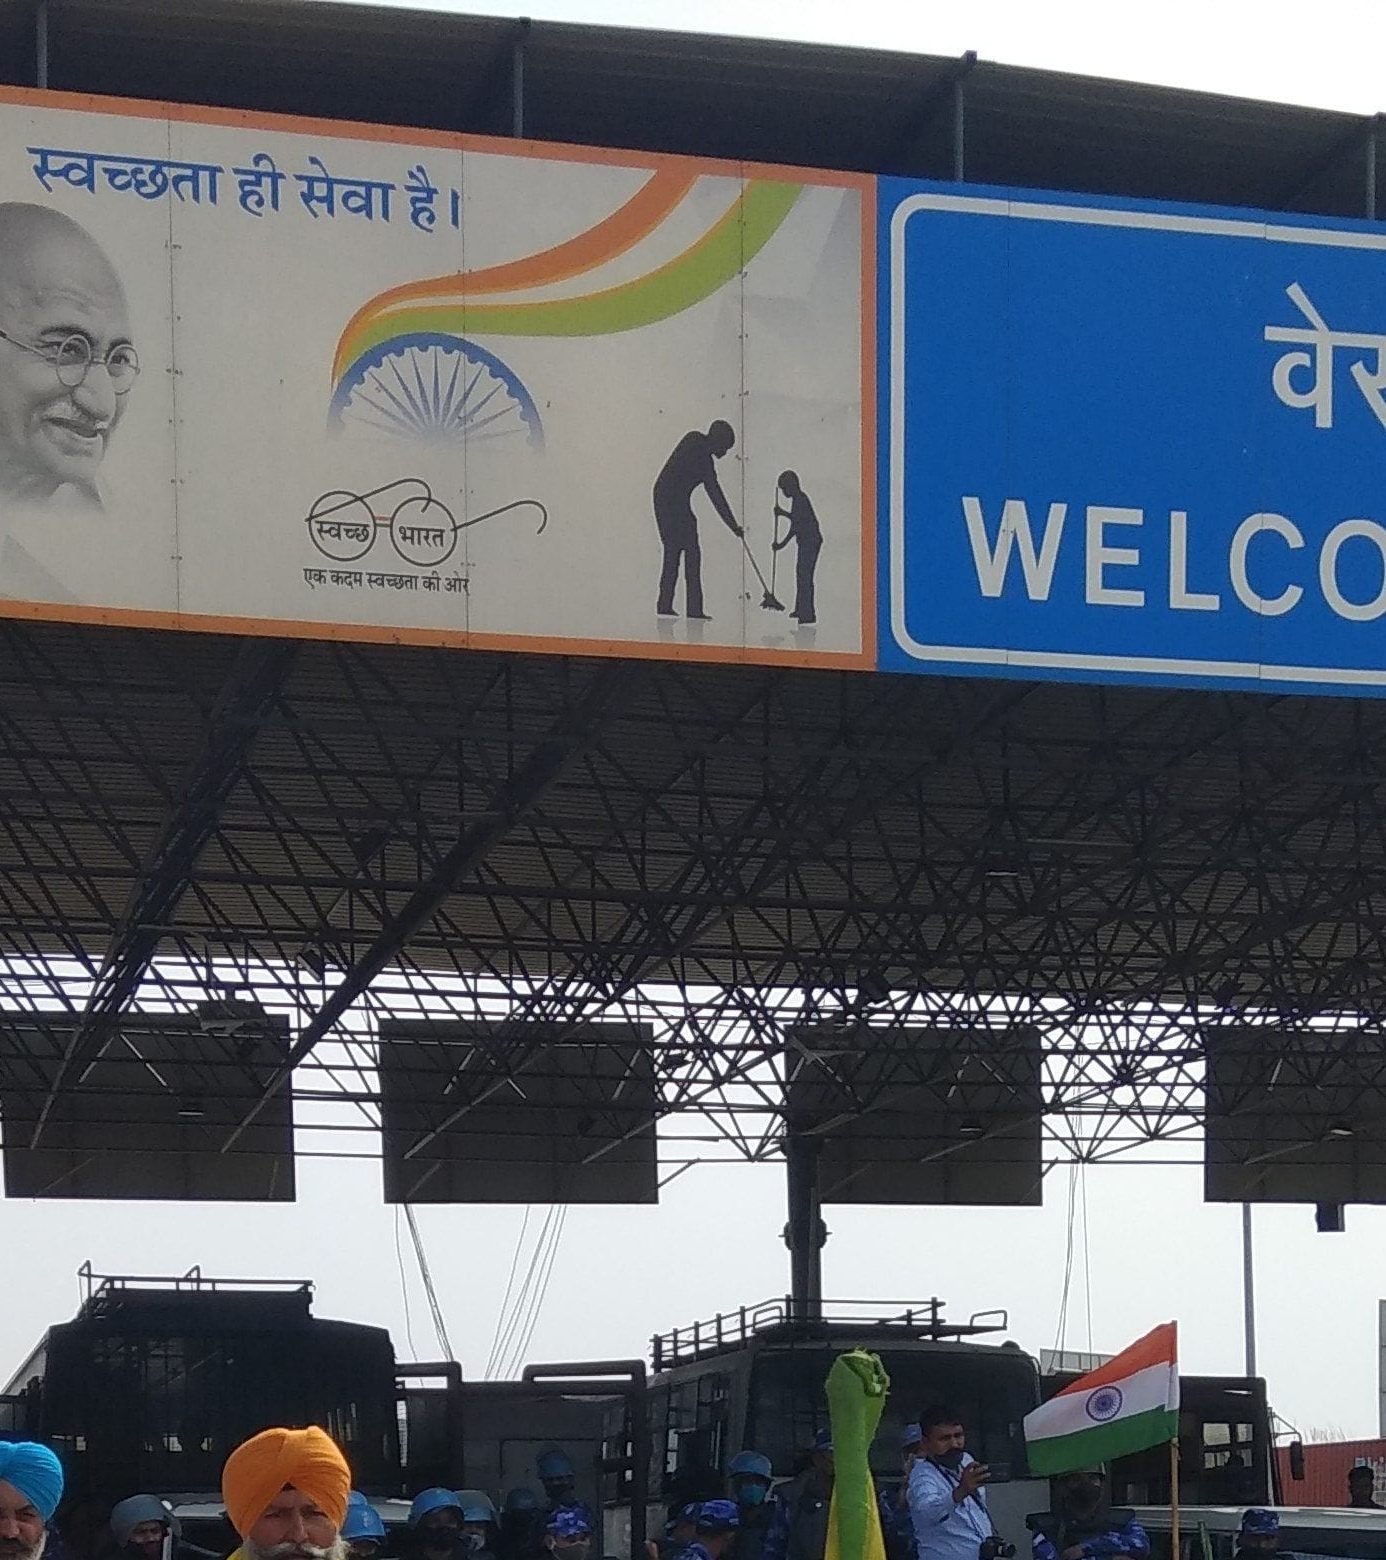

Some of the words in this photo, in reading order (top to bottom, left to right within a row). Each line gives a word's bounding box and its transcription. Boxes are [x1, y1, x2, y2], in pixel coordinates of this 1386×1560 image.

[28, 147, 221, 206] स्वच्छता
[233, 154, 285, 215] ही
[295, 157, 395, 220] सेवा
[314, 519, 371, 543] स्वच्छ
[398, 525, 446, 548] भारत
[303, 567, 327, 590] एक
[328, 569, 363, 590] कदम
[365, 571, 419, 591] स्वच्छता
[421, 570, 442, 592] की
[444, 570, 471, 597] ओर
